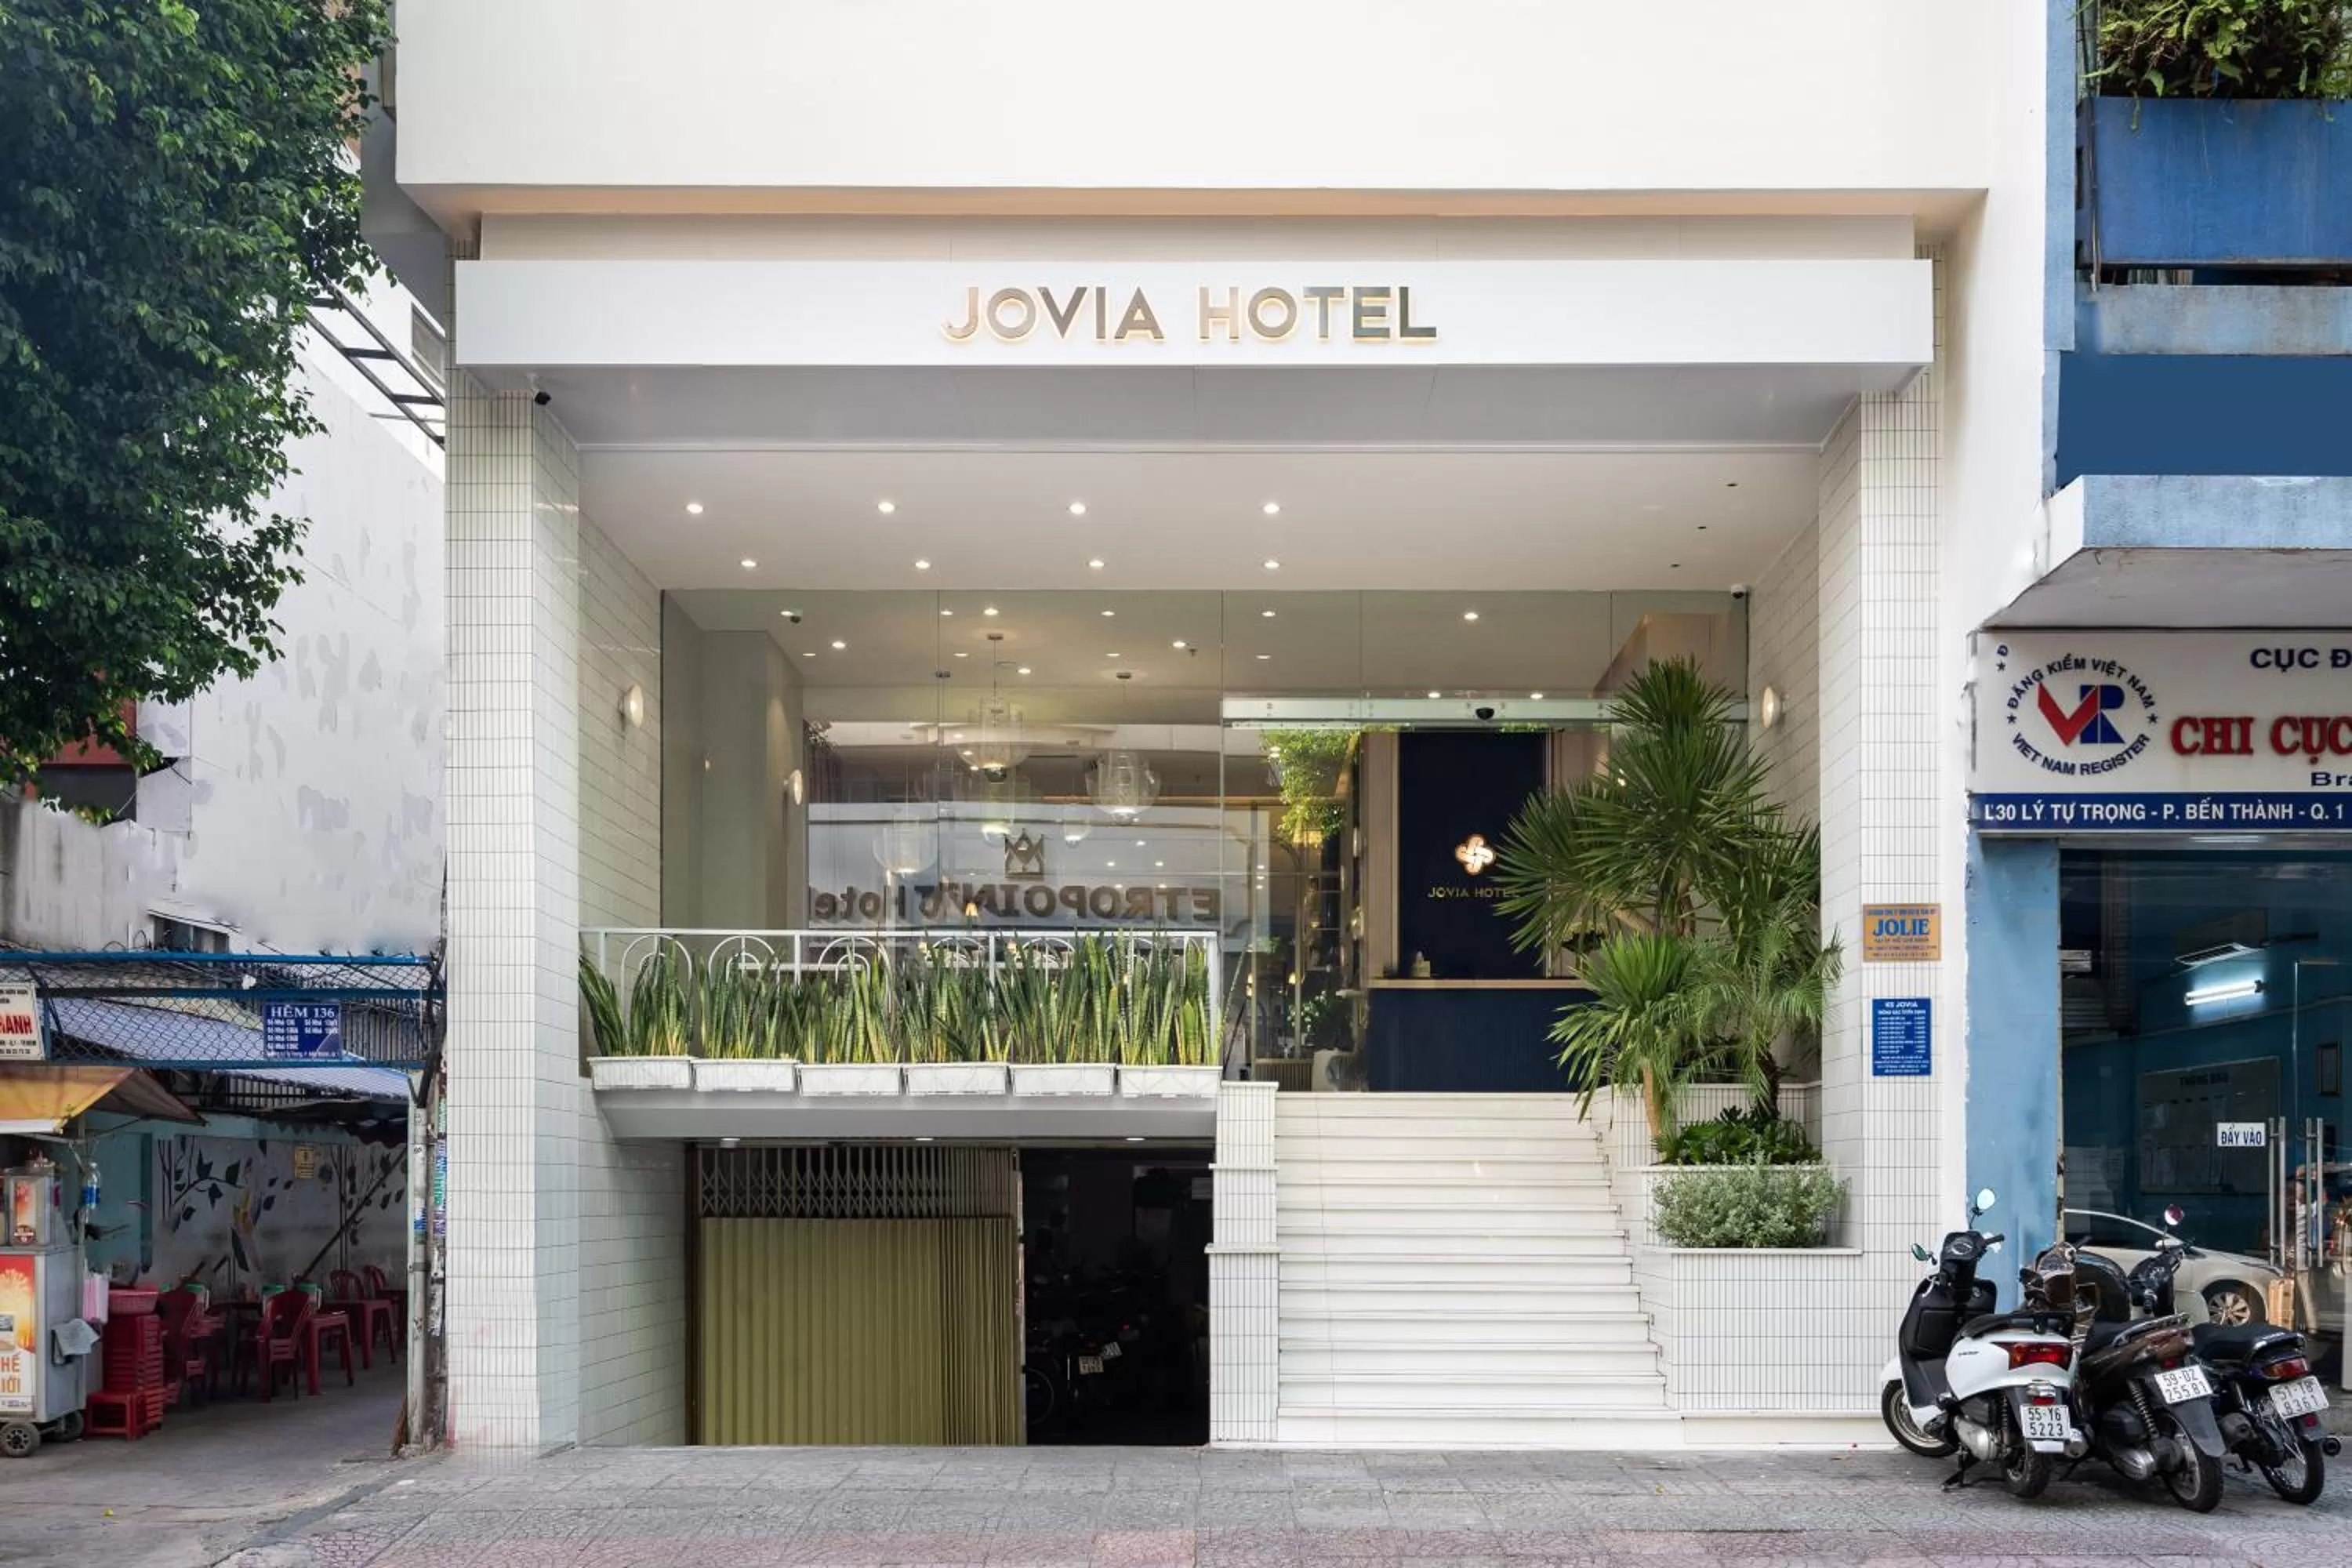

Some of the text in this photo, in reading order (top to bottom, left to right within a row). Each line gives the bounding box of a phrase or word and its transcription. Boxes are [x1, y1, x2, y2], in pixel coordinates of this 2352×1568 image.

[944, 286, 1437, 340] JOVIA HOTEL
[2249, 648, 2319, 673] CỤC
[2092, 658, 2127, 678] VIỆT
[2127, 675, 2155, 710] NAM
[2170, 716, 2352, 765] CHI CỤC
[2013, 732, 2151, 775] VIET NAM REGISTER
[2022, 799, 2045, 820] LÝ
[2051, 801, 2077, 824] TỰ
[2080, 804, 2146, 824] TRỌNG
[2163, 804, 2180, 820] P.
[2185, 797, 2224, 819] BẾN
[2230, 799, 2293, 820] THÀNH
[2310, 803, 2330, 820] Q.
[2335, 804, 2344, 819] 1
[1428, 887, 1469, 898] JOVIA
[1872, 918, 1930, 937] JOLIE
[314, 1007, 336, 1018] 136
[2243, 1127, 2262, 1145] VÀO
[2030, 1422, 2063, 1436] 5223
